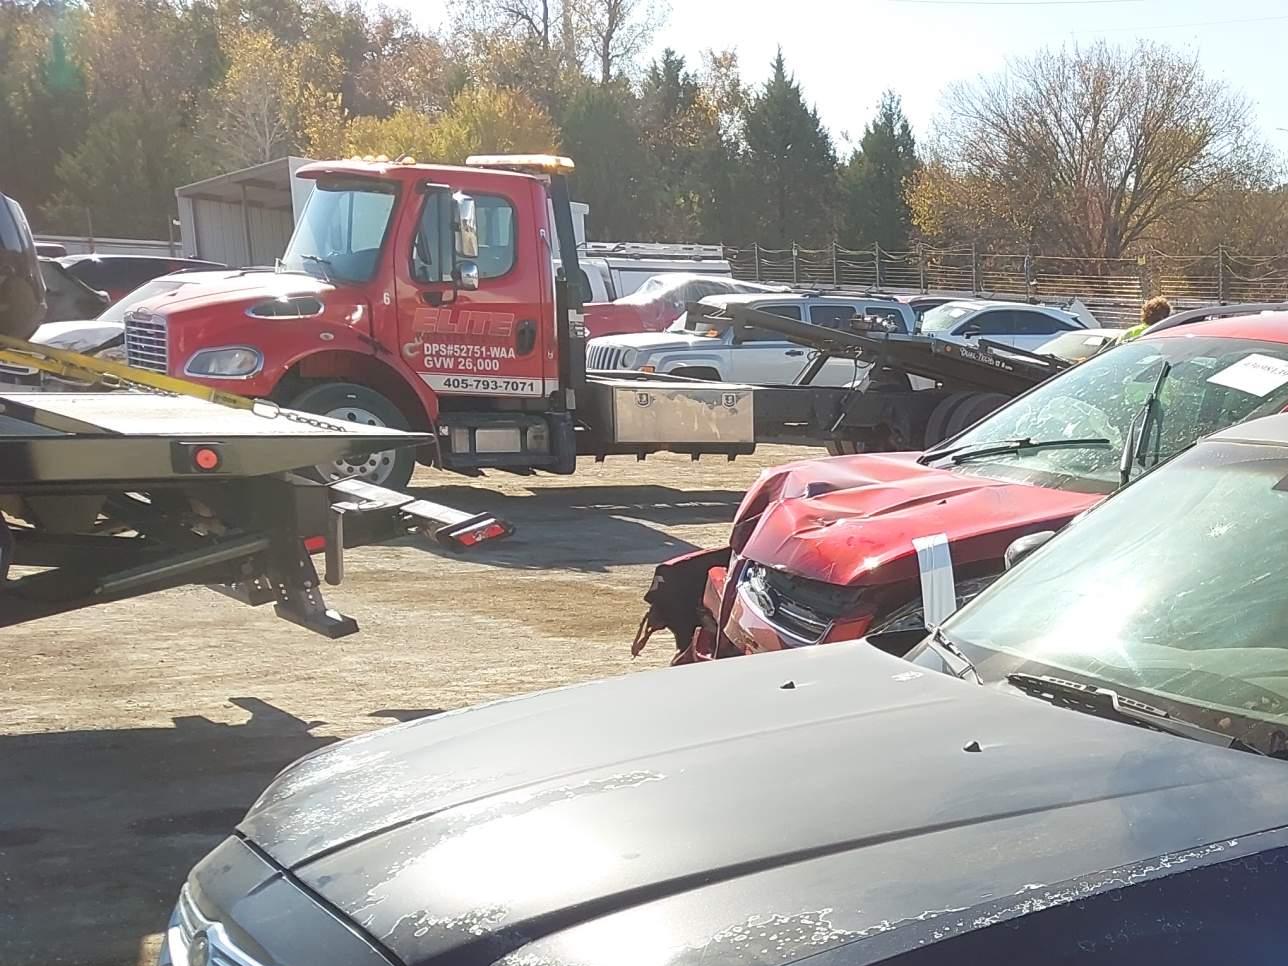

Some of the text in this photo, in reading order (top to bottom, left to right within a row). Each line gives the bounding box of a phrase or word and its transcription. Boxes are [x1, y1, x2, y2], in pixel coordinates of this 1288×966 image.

[383, 292, 391, 305] 6
[413, 308, 515, 336] ELITE
[423, 343, 516, 359] DPS#52751-WAA
[423, 357, 500, 373] GVW 26,000
[443, 377, 535, 392] 405-793-7071
